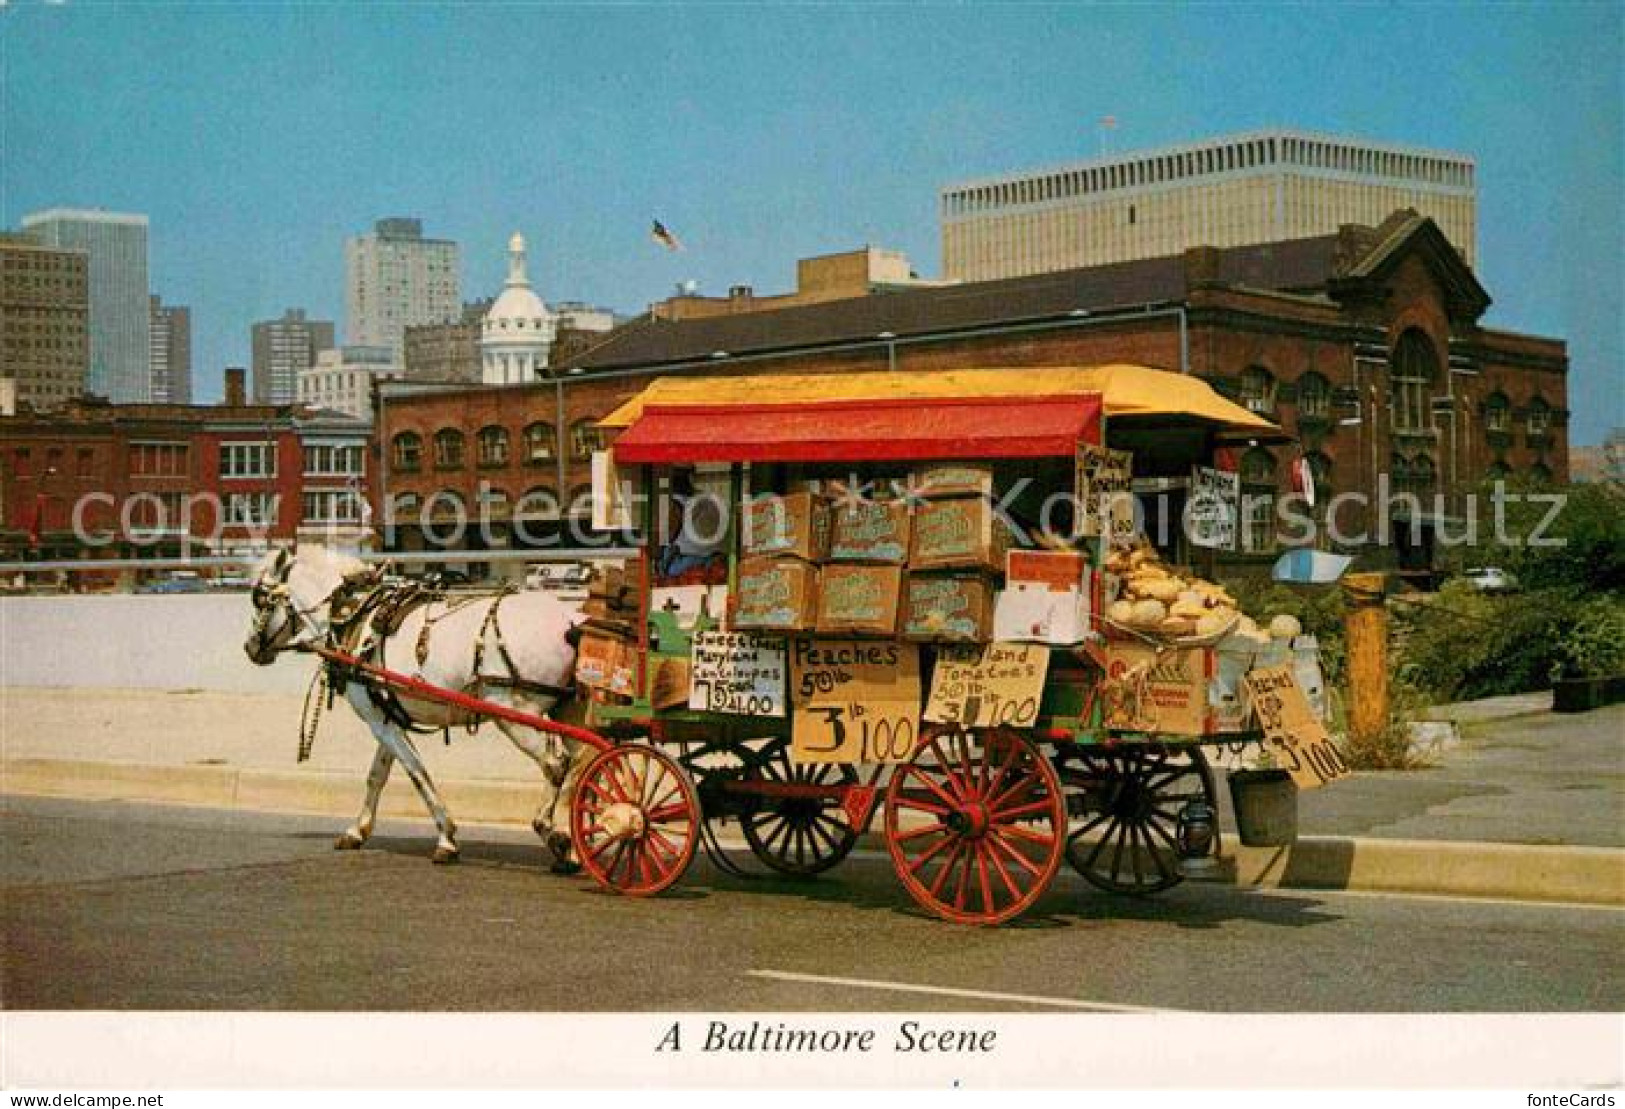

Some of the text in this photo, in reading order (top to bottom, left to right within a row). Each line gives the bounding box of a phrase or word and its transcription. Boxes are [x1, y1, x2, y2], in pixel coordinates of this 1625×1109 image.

[796, 641, 897, 667] Peaches
[937, 701, 961, 721] 3
[803, 707, 846, 753] 3
